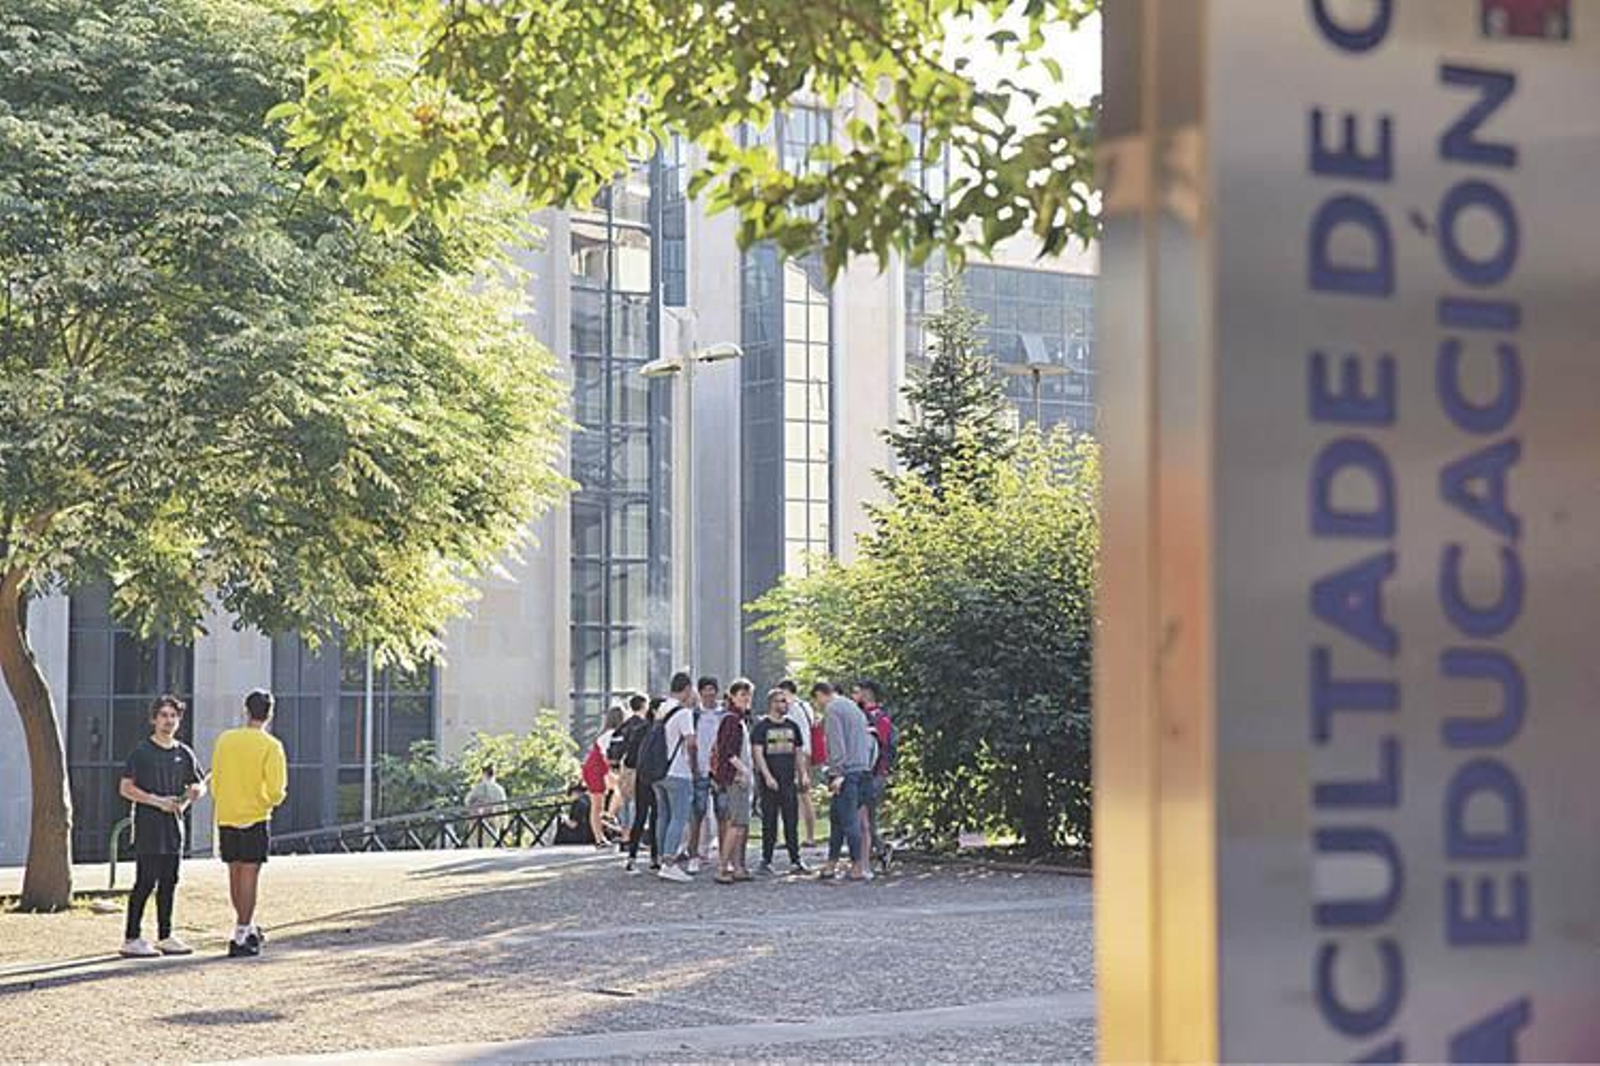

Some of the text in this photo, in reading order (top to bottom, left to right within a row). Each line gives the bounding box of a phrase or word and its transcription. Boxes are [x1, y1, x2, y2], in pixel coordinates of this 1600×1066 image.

[1309, 107, 1396, 298] DE
[1407, 62, 1530, 948] EDUCACIÓN
[1309, 351, 1405, 1066] CULTADE
